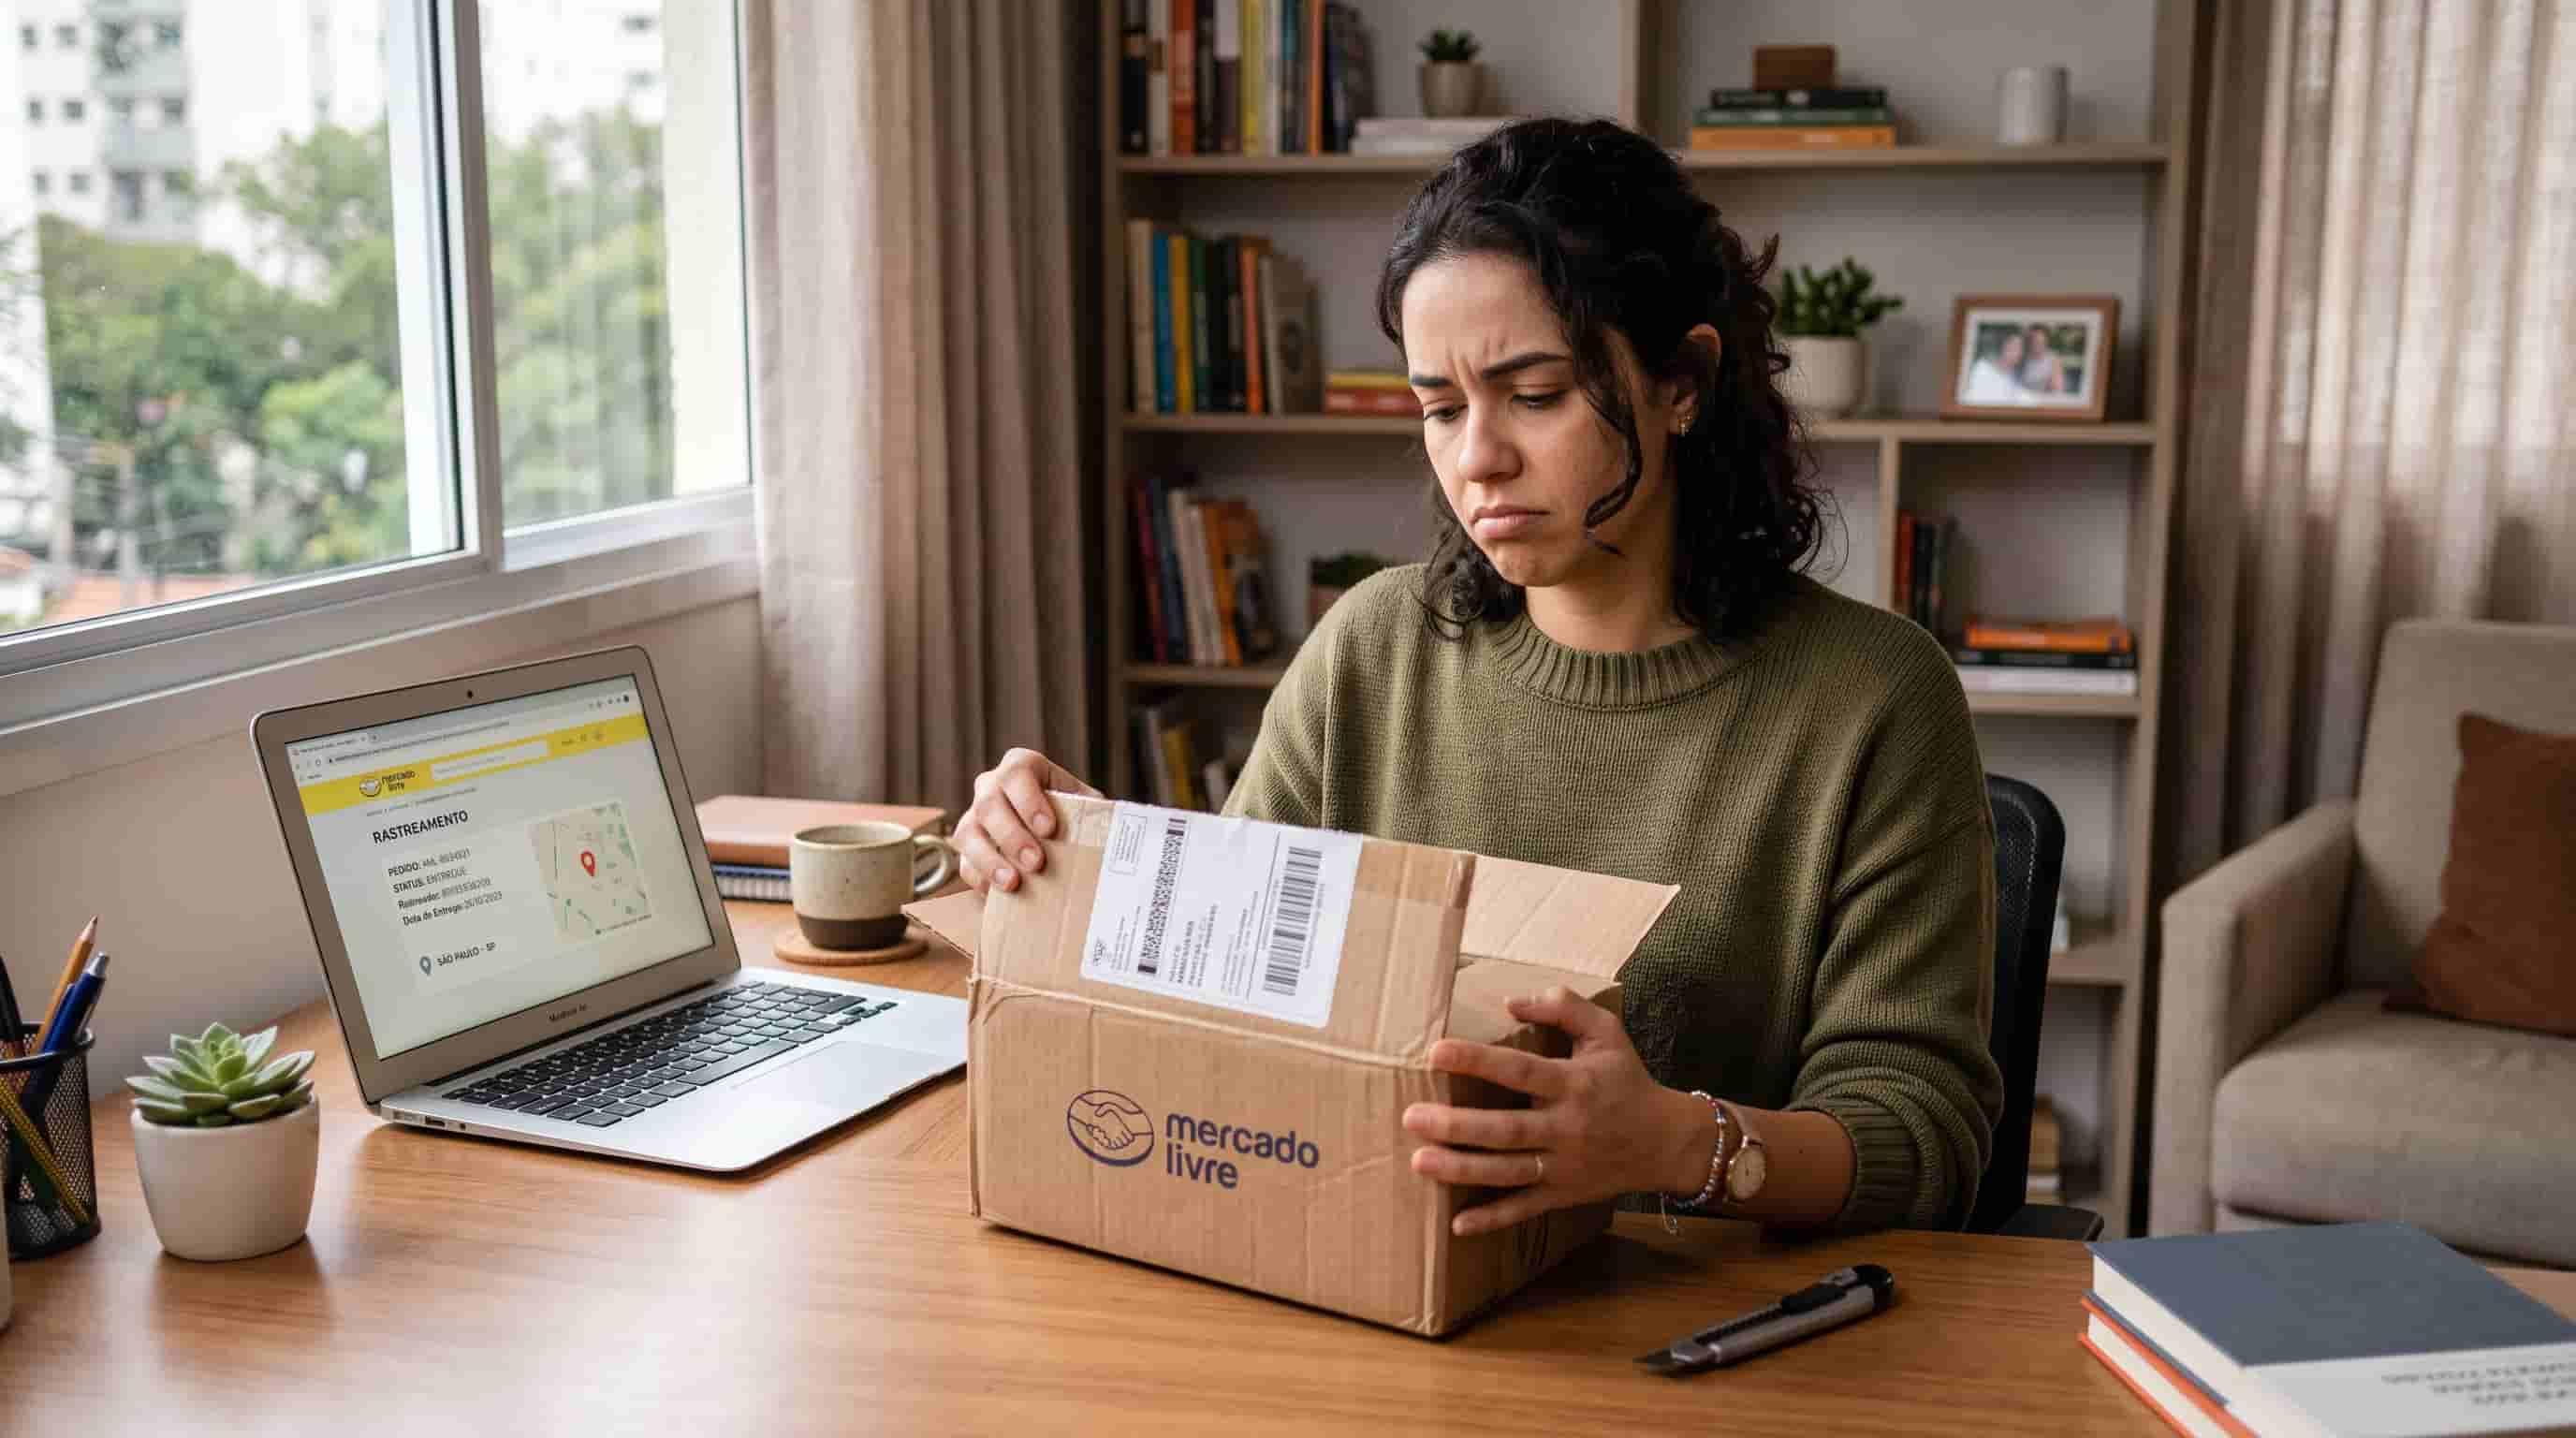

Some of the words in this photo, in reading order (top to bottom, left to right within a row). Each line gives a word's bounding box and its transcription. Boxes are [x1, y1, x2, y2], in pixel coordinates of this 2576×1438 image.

[373, 810, 469, 844] RASTREAMENTO
[1166, 1112, 1320, 1168] mercado
[1166, 1142, 1238, 1189] livre
